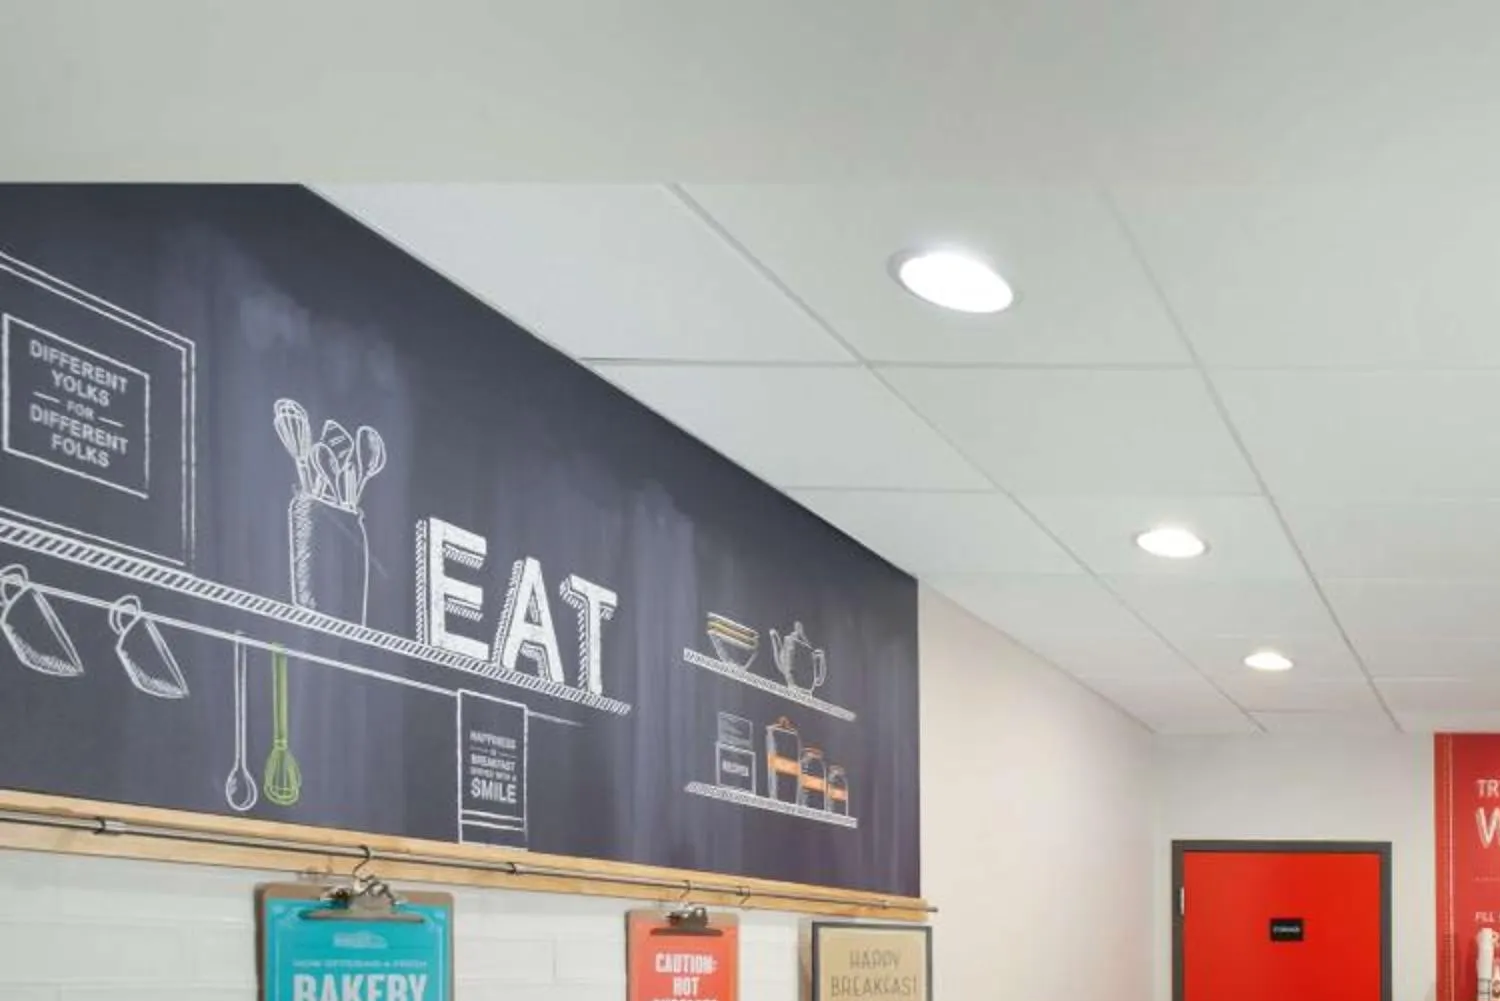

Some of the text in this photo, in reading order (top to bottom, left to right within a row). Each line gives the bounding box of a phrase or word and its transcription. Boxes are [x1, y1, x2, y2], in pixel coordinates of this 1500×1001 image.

[29, 339, 129, 394] DIFFERENT
[51, 369, 110, 407] YOLKS
[66, 403, 94, 420] FOR
[29, 404, 129, 454] DIFFERENT
[51, 434, 110, 468] FOLKS
[415, 516, 618, 696] EAT
[471, 777, 517, 804] SMILE
[1475, 911, 1495, 923] FILL
[849, 949, 902, 970] HAPPY
[673, 976, 700, 997] HOT
[830, 975, 918, 998] BREAKFAST
